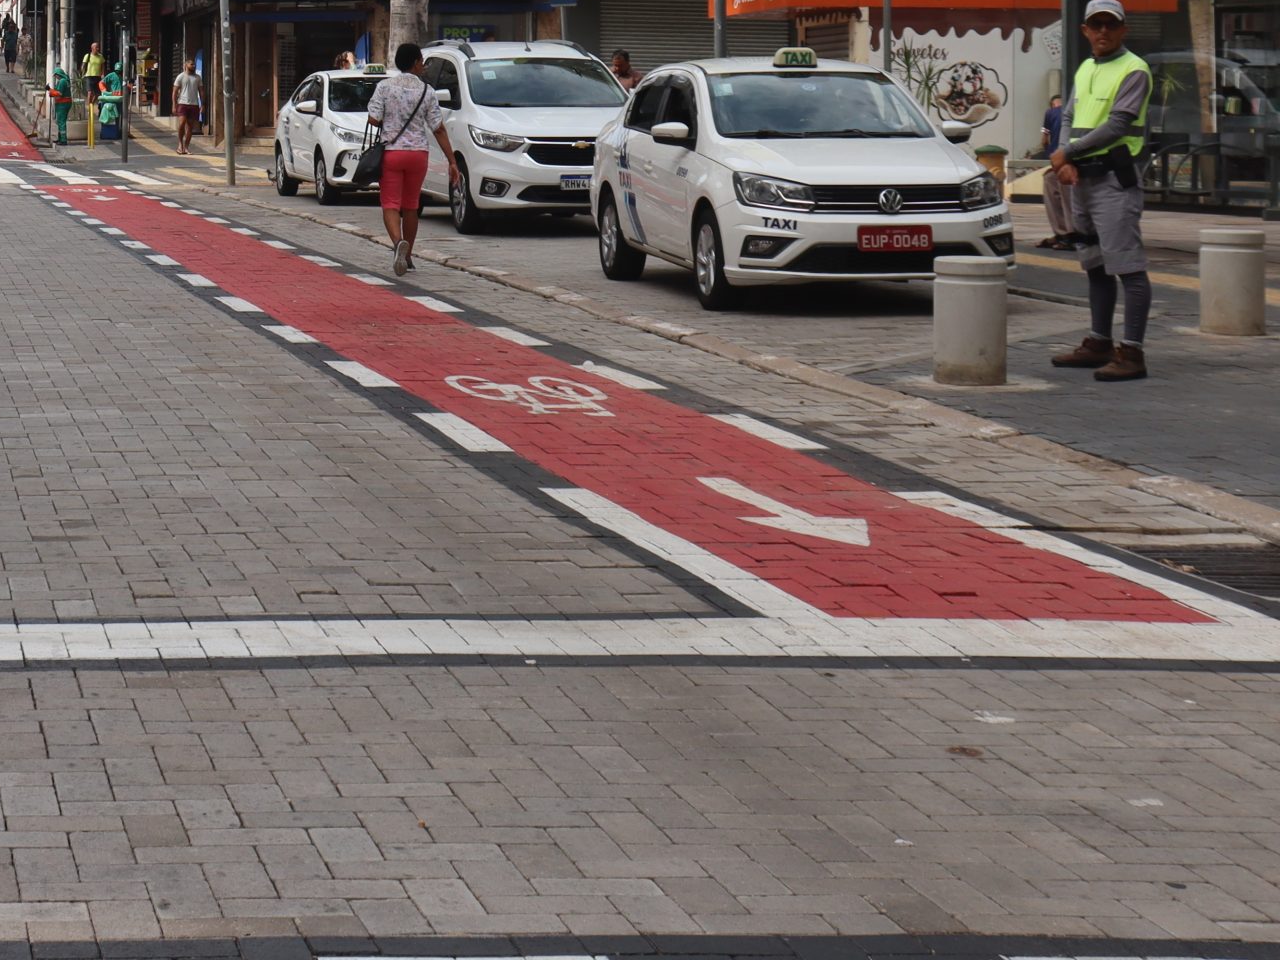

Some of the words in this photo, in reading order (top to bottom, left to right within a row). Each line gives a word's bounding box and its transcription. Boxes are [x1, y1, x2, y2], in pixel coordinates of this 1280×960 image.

[782, 51, 812, 65] TAXI
[368, 65, 384, 73] TAXI
[762, 217, 798, 230] TAXI
